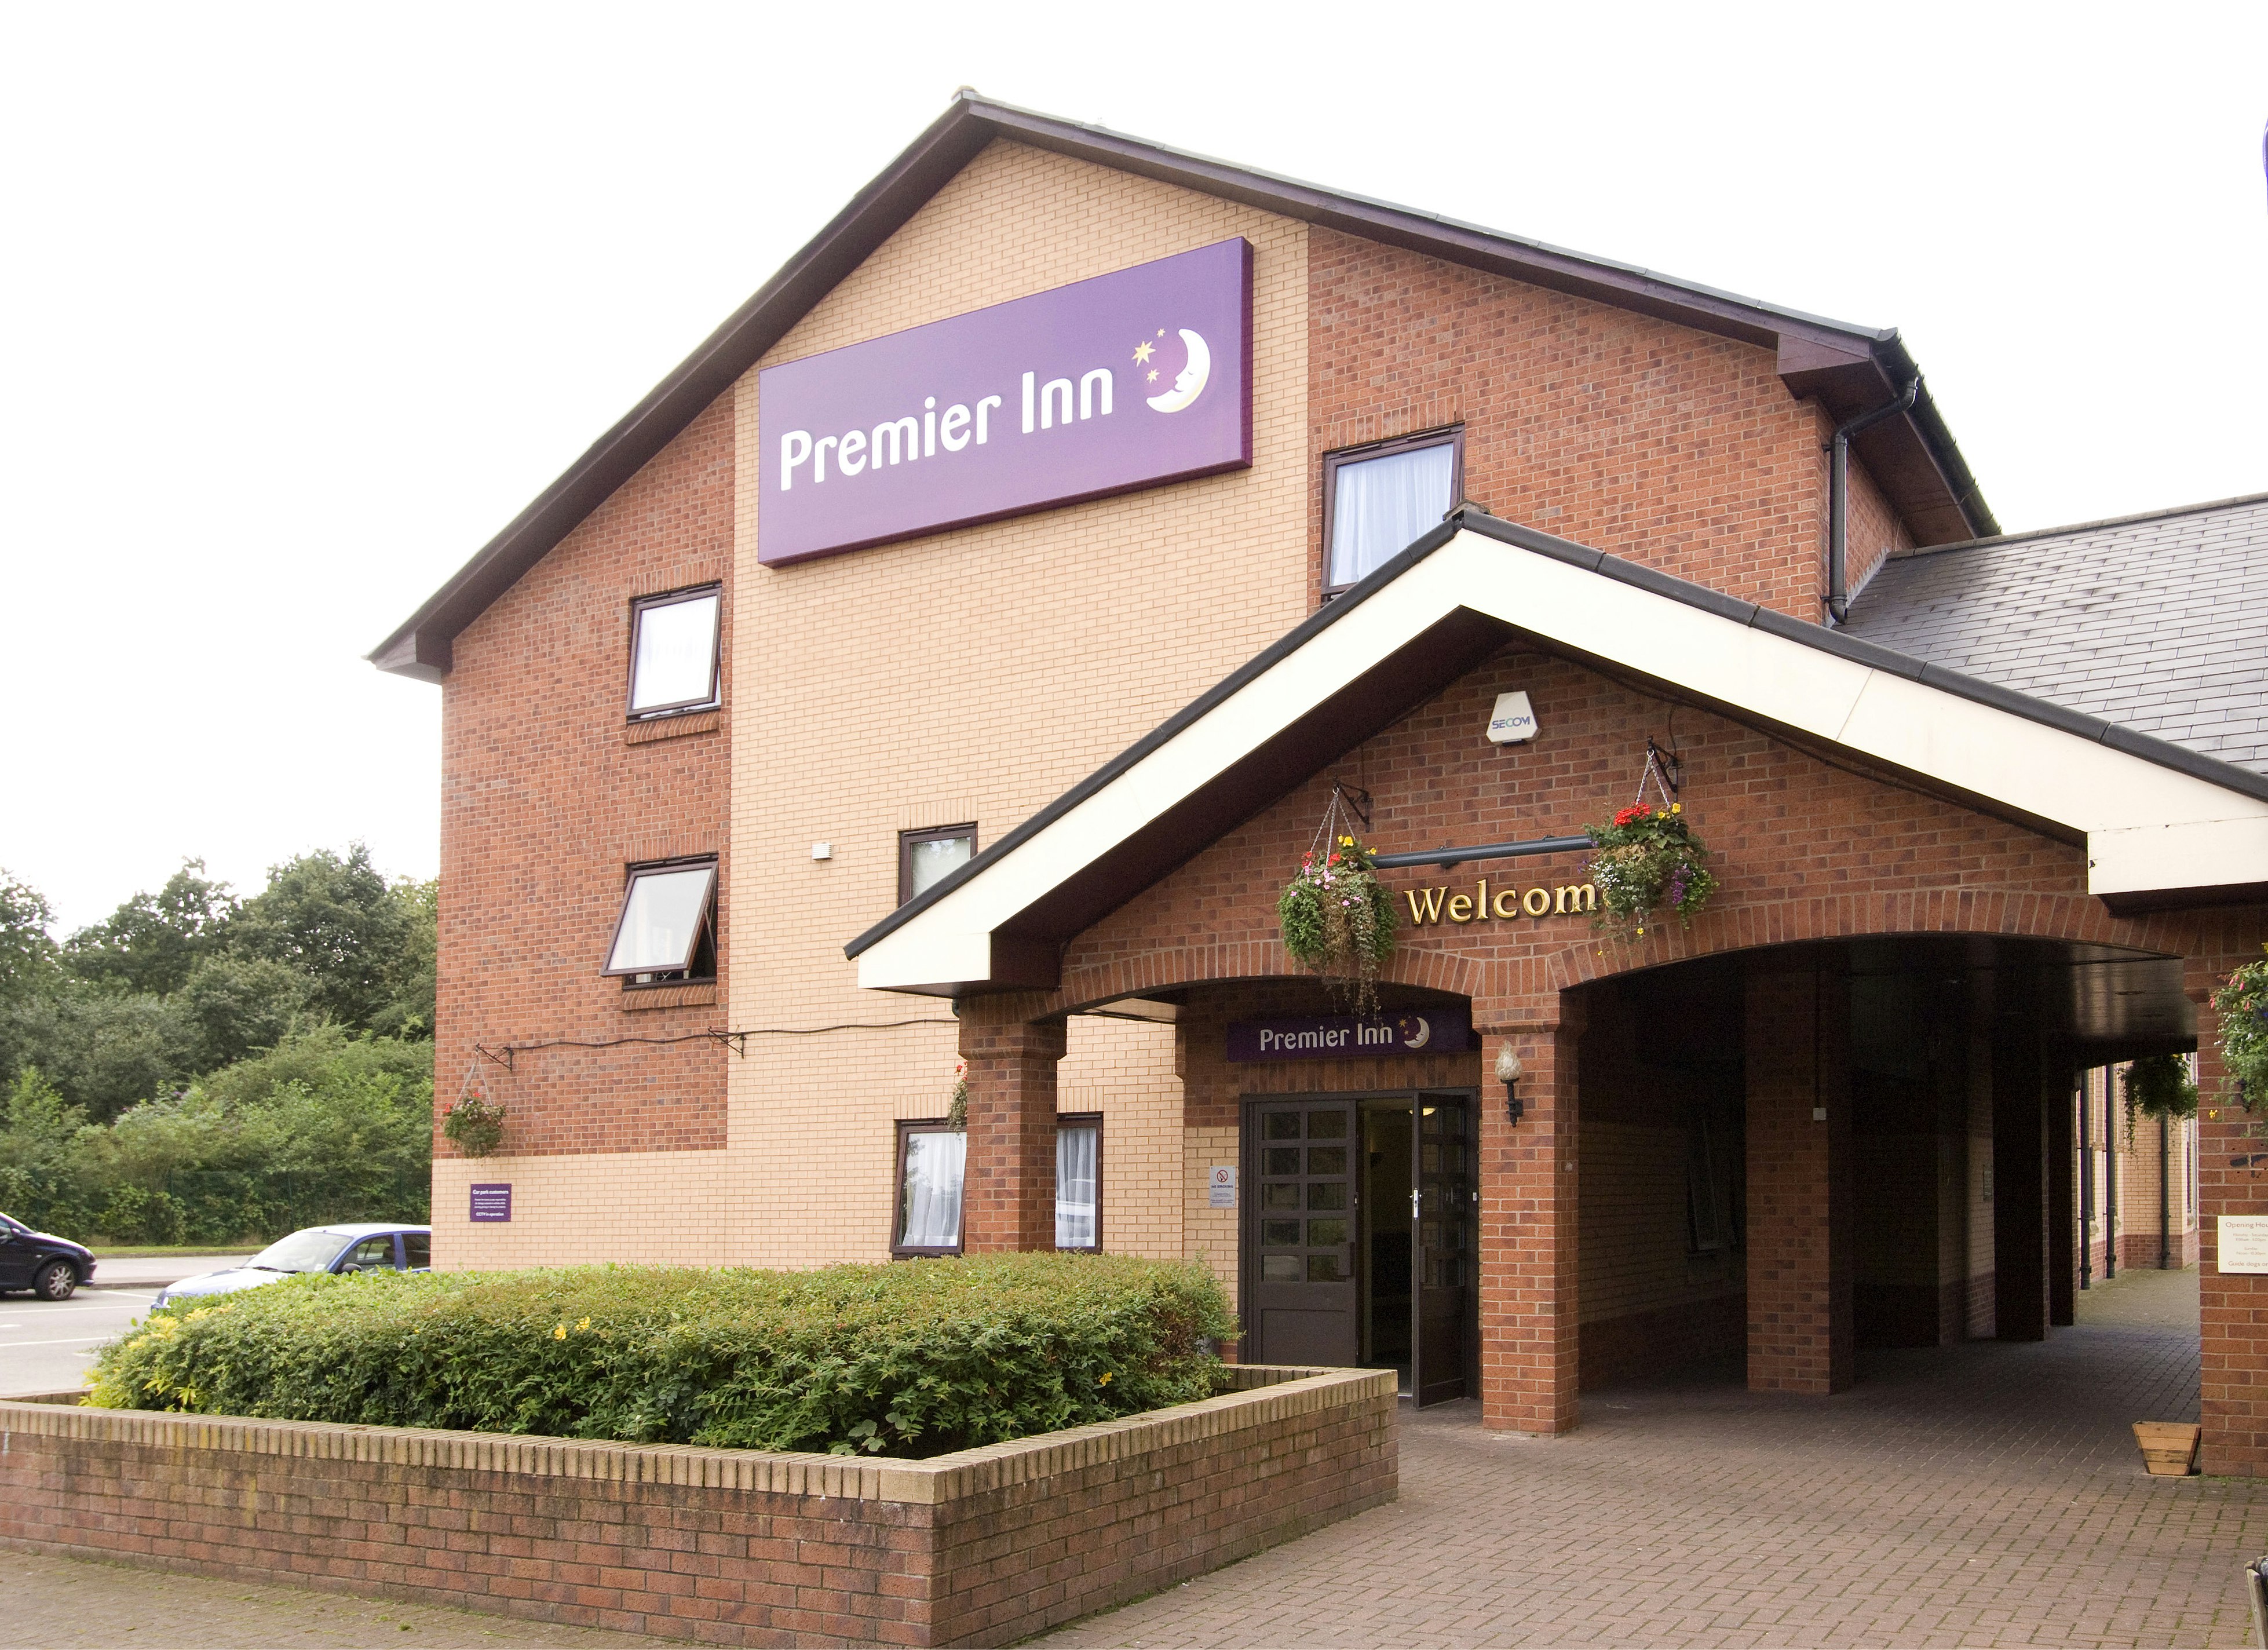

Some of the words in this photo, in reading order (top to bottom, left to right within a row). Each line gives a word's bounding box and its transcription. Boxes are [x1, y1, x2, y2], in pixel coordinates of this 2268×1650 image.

[780, 395, 1002, 491] Premier
[1021, 367, 1113, 434] Inn
[1492, 716, 1531, 729] SECOM
[1403, 878, 1611, 925] Welcom
[1260, 1025, 1350, 1051] Premier
[1357, 1023, 1393, 1045] Inn
